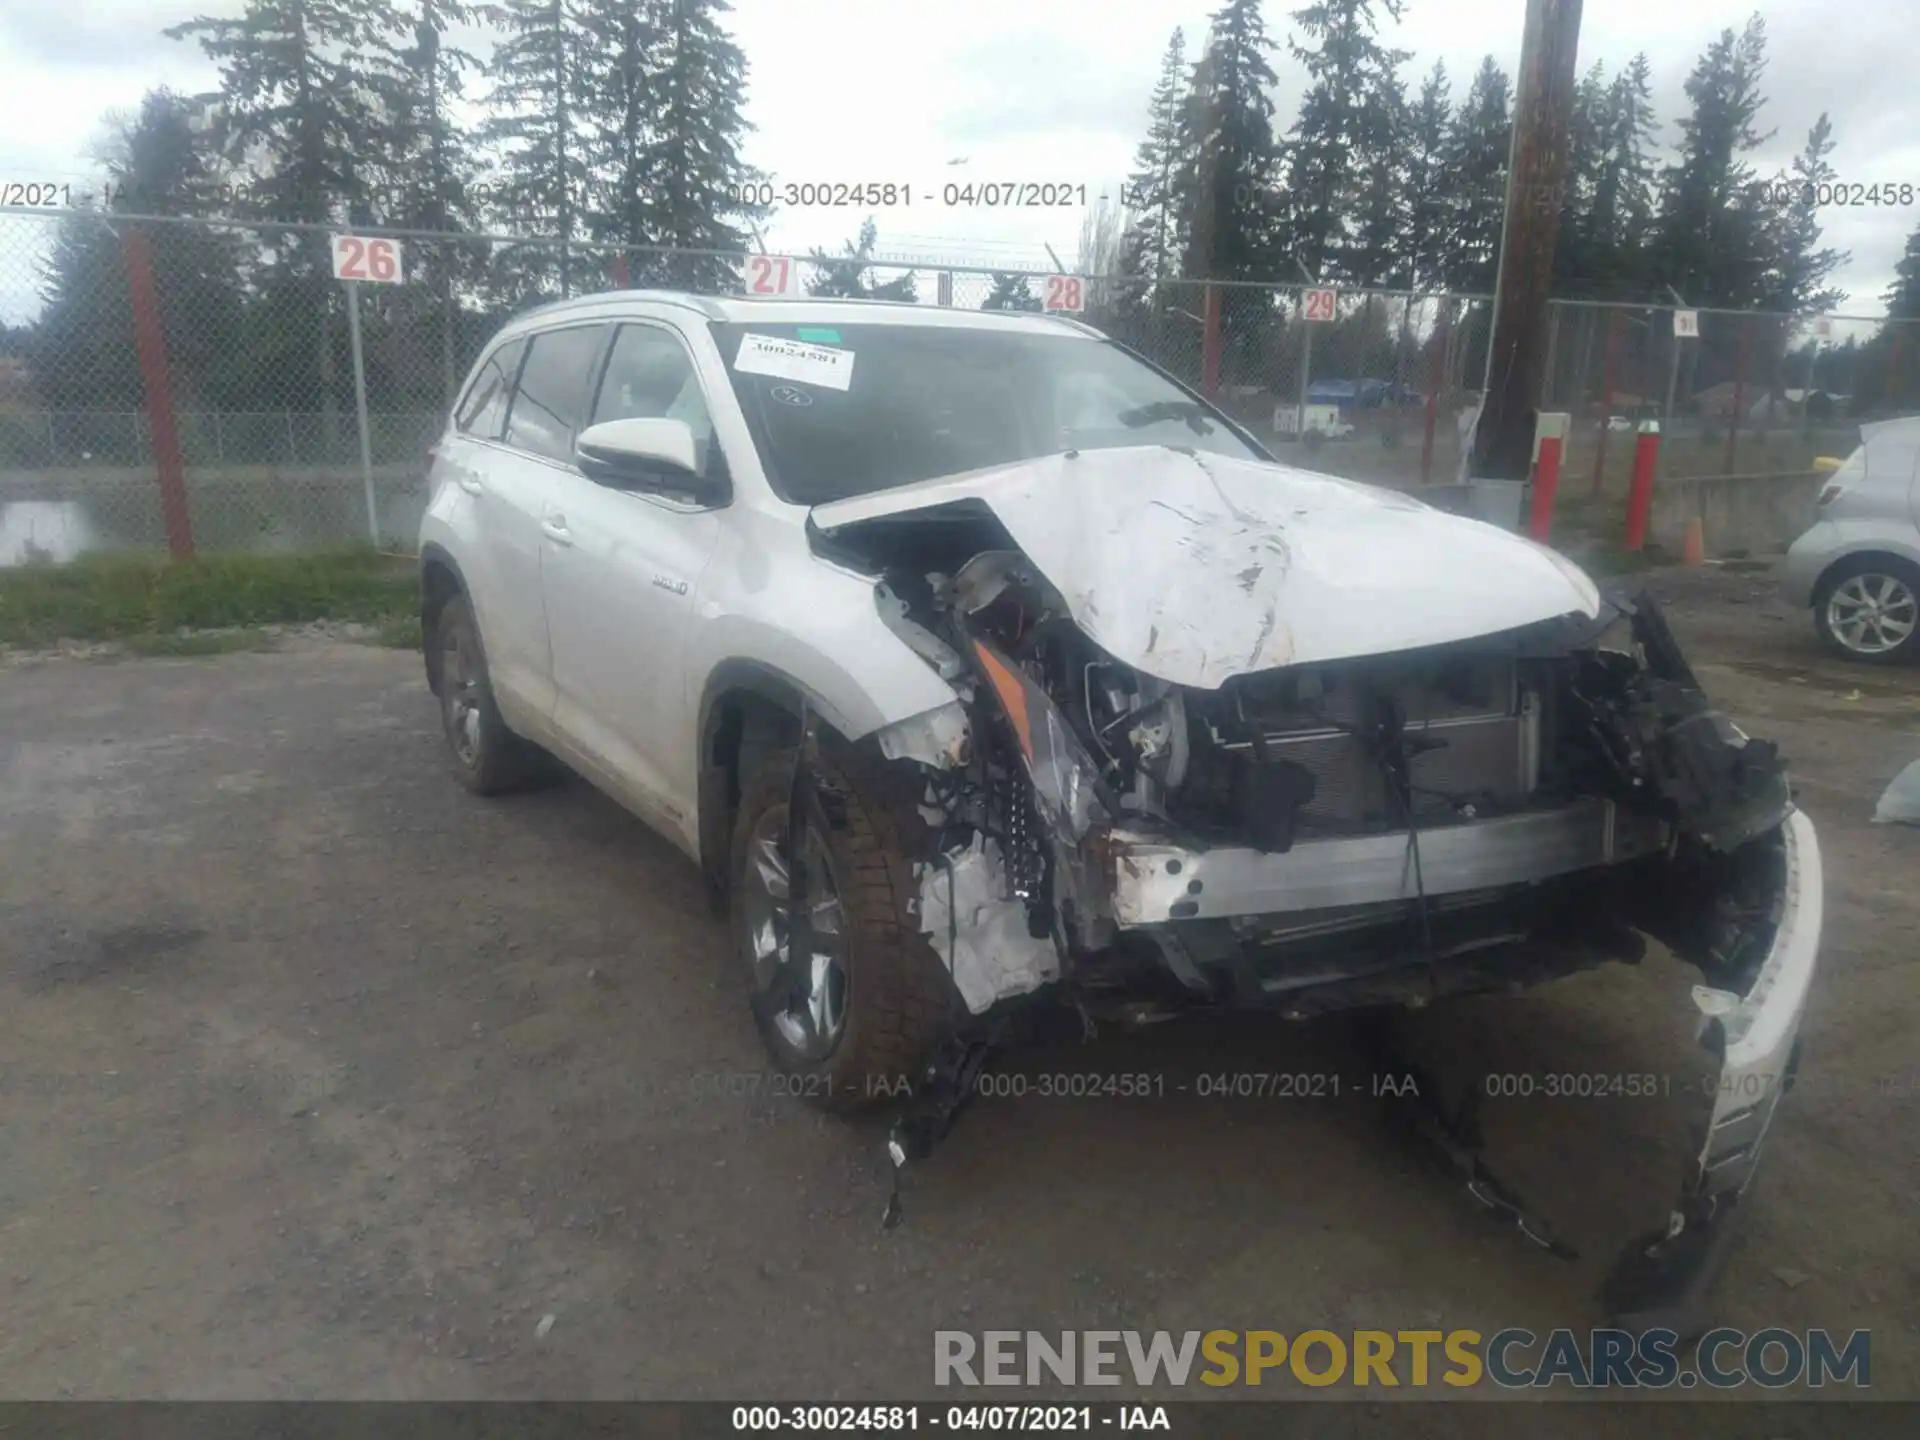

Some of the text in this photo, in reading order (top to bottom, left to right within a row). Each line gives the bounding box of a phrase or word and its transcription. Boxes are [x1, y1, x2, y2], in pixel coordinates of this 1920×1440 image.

[339, 238, 396, 280] 26
[751, 256, 788, 293] 27
[1046, 276, 1081, 309] 28
[1307, 291, 1334, 320] 29
